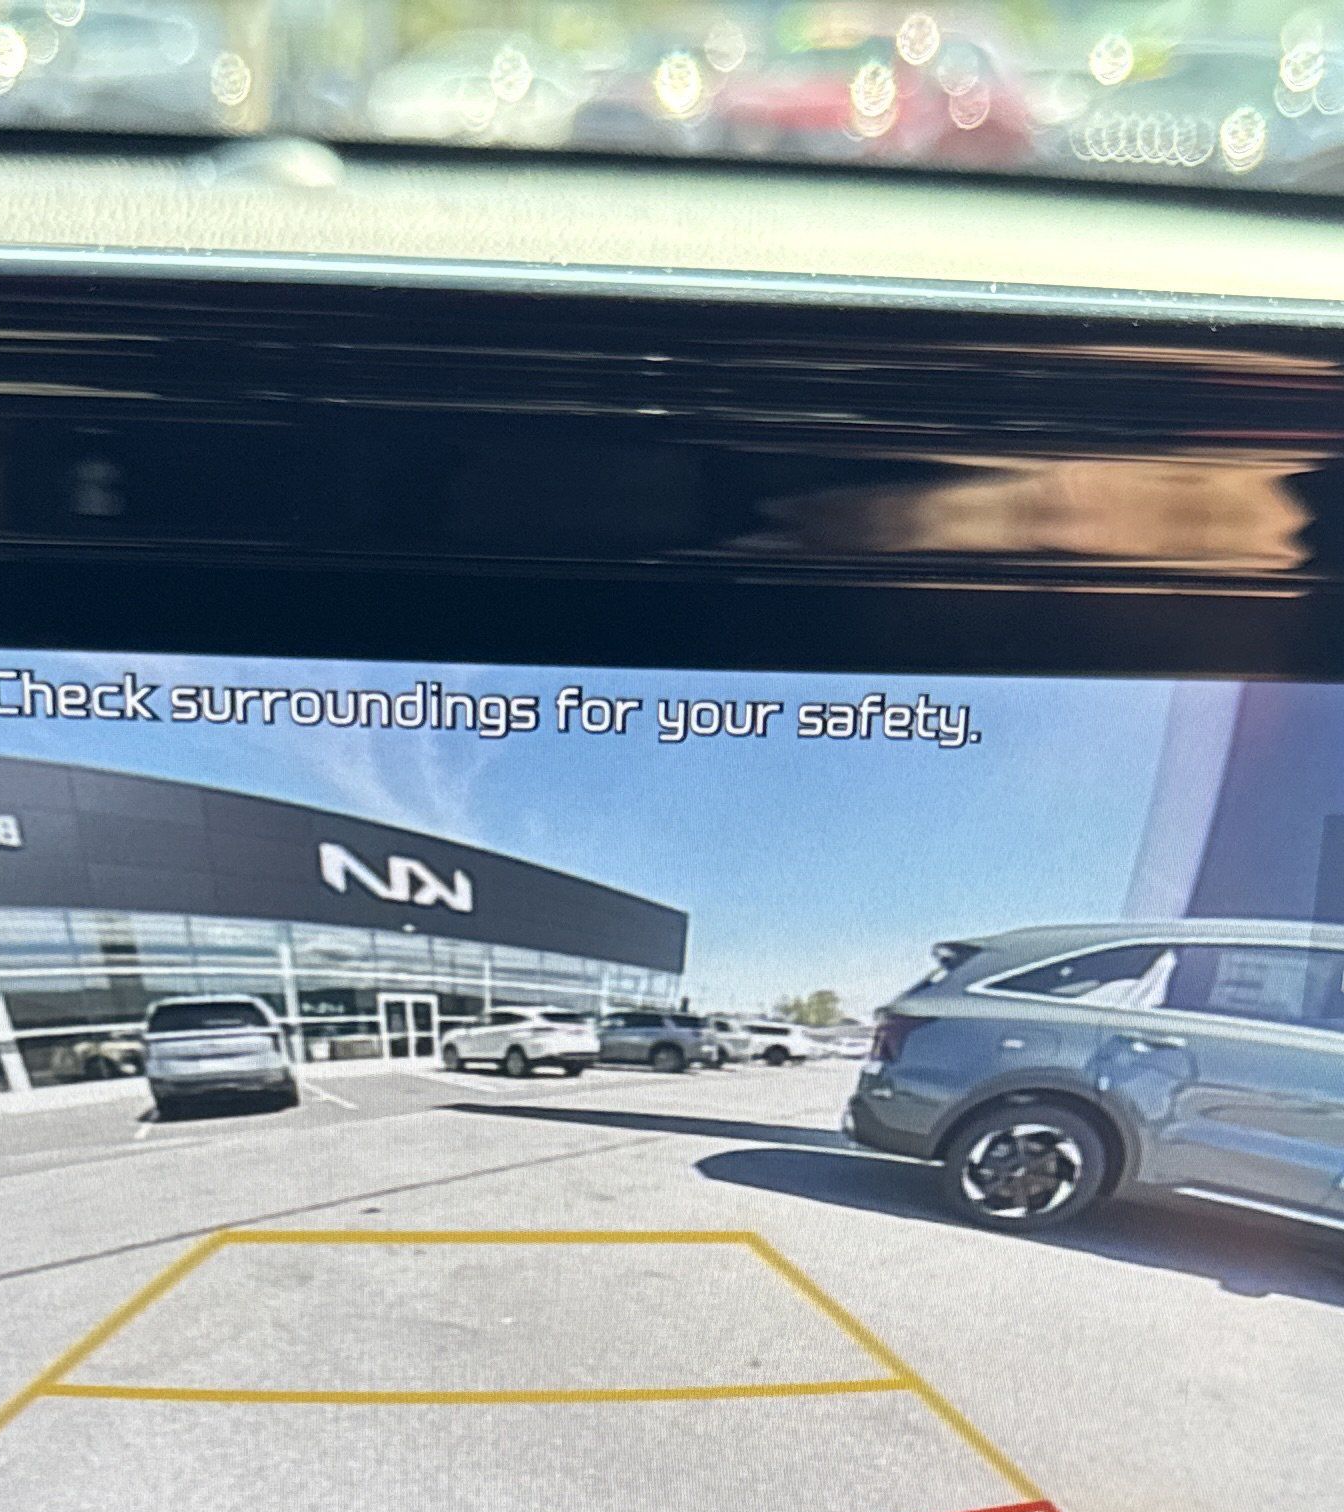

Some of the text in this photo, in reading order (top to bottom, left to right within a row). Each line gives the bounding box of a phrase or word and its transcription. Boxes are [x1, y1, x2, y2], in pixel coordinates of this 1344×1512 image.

[171, 681, 541, 738] surroundings
[555, 685, 643, 736] for
[658, 699, 784, 743] your
[797, 692, 982, 748] safety.
